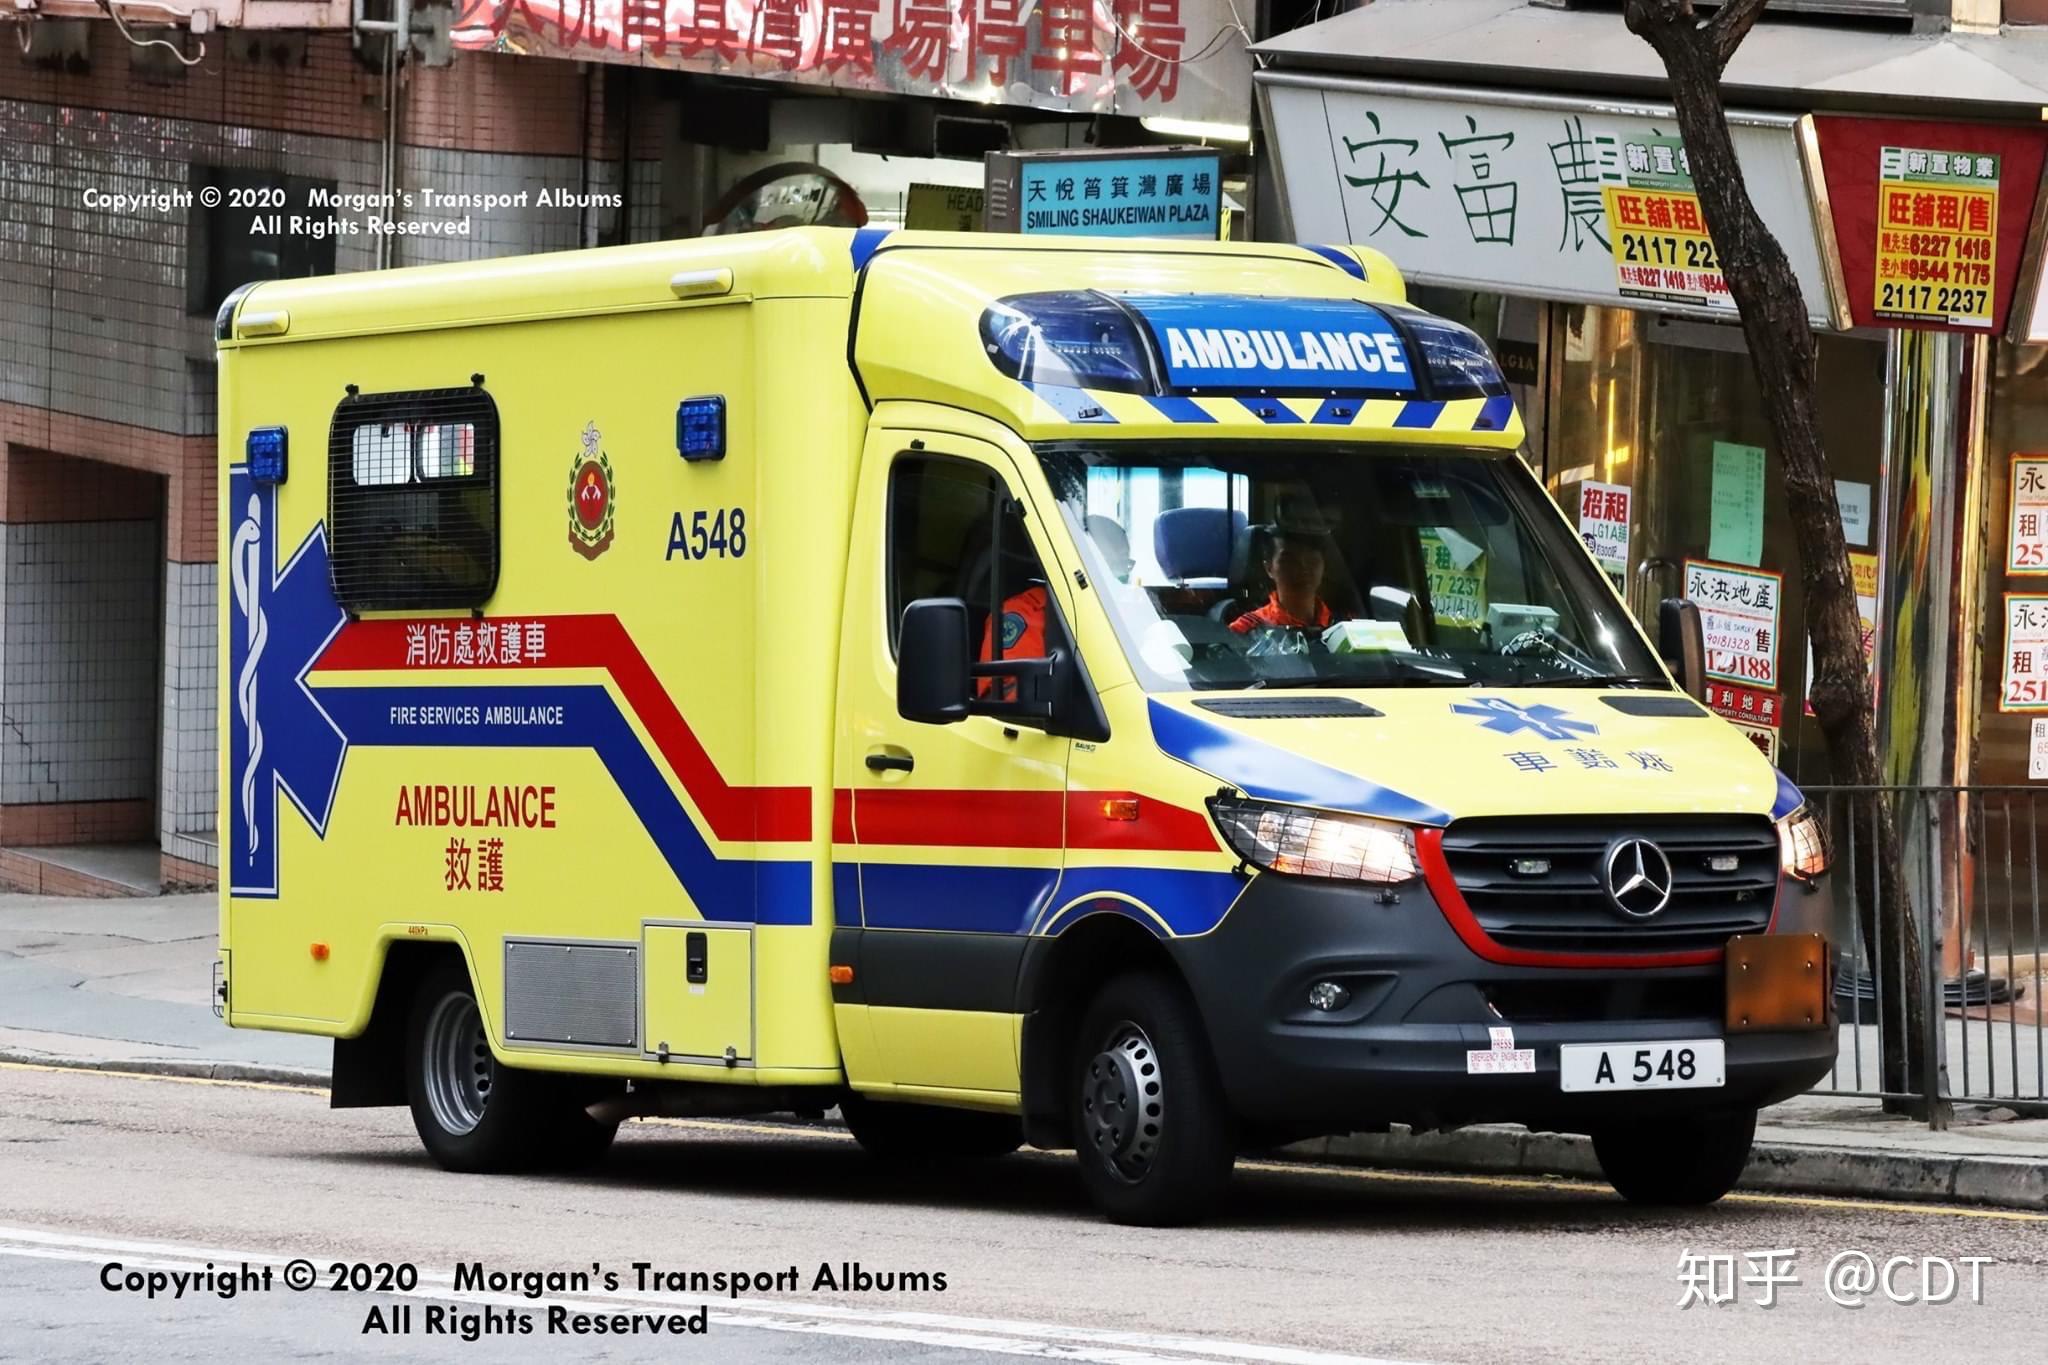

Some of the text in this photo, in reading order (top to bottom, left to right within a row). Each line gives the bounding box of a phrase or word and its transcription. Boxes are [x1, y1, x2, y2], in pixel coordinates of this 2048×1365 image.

[1028, 173, 1211, 202] 天悅筲箕灣廣場
[1342, 110, 1662, 253] 安富農
[1027, 204, 1209, 229] SMILING SHAUKEIWAN PLAZA
[1622, 234, 1723, 269] 2117 22
[1910, 233, 1950, 258] 6227
[1955, 237, 1991, 260] 1418
[1637, 267, 1662, 288] 6227
[1663, 269, 1685, 290] 1418
[1703, 274, 1729, 294] 9544
[1909, 259, 1950, 283] 9544
[1953, 262, 1991, 286] 7175
[1882, 284, 1988, 314] 2117 2237
[1167, 328, 1406, 372] AMBULANCE
[2019, 466, 2048, 493] 永
[1583, 488, 1628, 523] 招租
[666, 508, 746, 561] A548
[2018, 513, 2037, 537] 租
[2015, 543, 2048, 566] 25
[1448, 575, 1480, 597] 2237
[1689, 571, 1774, 611] 永洪地產
[406, 621, 547, 667] 消防處救護車
[1707, 633, 1750, 651] 90181328
[1755, 628, 1771, 653] 售
[2012, 650, 2032, 674] 租
[390, 706, 564, 726] FIRE SERVICES AMBULANCE
[395, 785, 556, 828] AMBULANCE
[445, 837, 504, 893] 救護
[1493, 1038, 1513, 1049] PRESS
[1595, 1048, 1696, 1084] A 548
